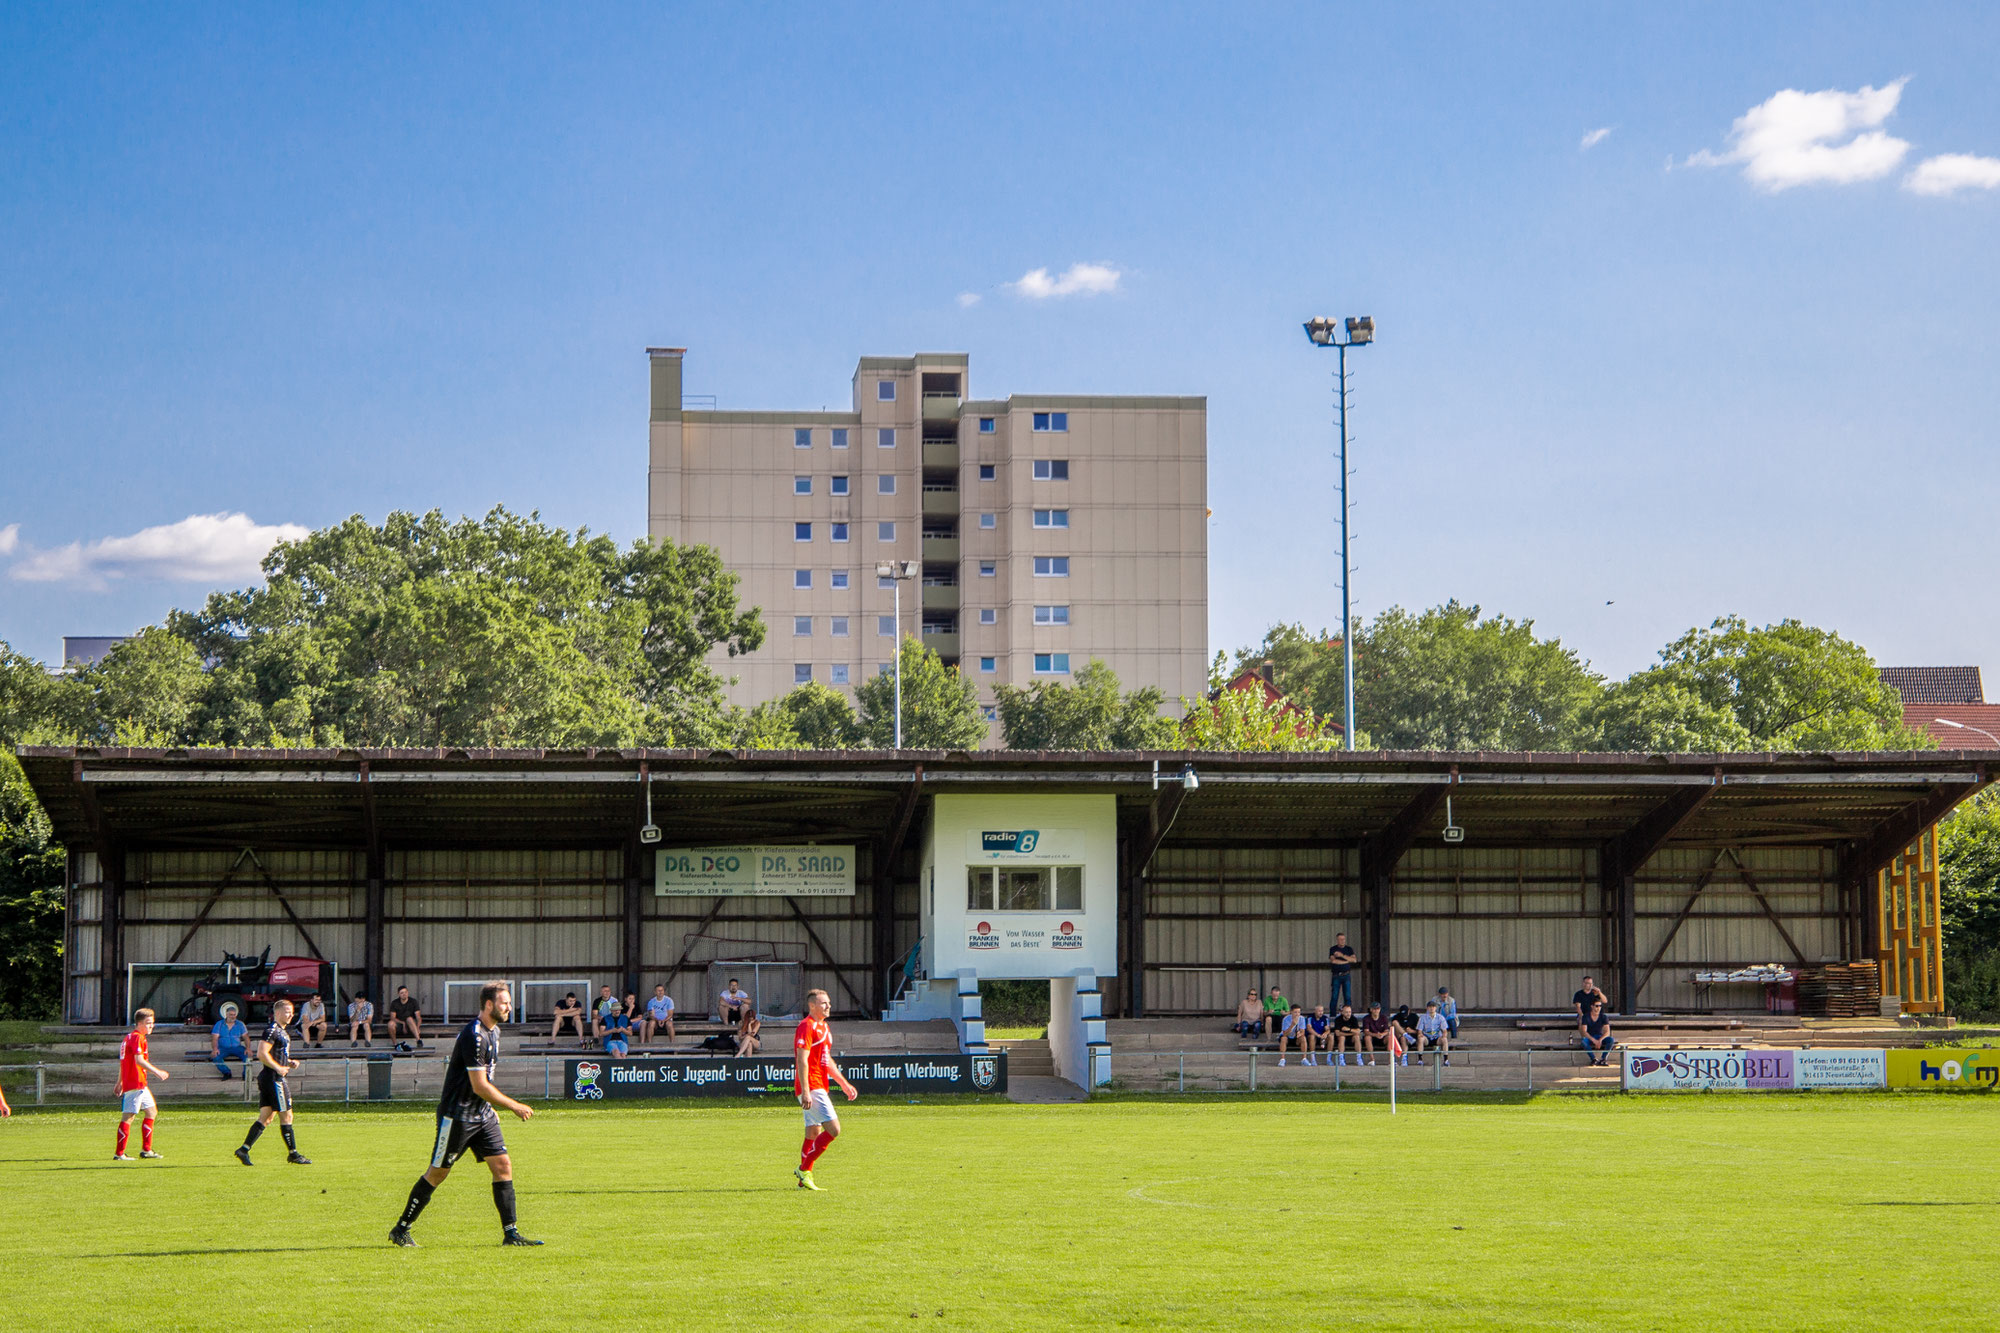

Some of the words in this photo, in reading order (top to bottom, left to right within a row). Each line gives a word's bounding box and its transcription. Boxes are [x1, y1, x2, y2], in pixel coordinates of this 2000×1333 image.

[984, 832, 1017, 841] radio
[1021, 834, 1035, 852] 8
[665, 856, 695, 872] DR.
[702, 856, 740, 872] DEO
[762, 856, 791, 872] DR.
[798, 856, 845, 872] SAAD
[611, 1066, 656, 1082] Fördern
[660, 1066, 679, 1082] Sie
[683, 1065, 732, 1084] Jugend-
[736, 1065, 760, 1081] und
[848, 1064, 870, 1079] mit
[873, 1062, 902, 1079] Ihrer
[905, 1062, 961, 1081] Werbung.
[1673, 1052, 1789, 1079] STRÖBEL
[1674, 1080, 1701, 1088] Mieder
[1746, 1080, 1790, 1088] Bademoden
